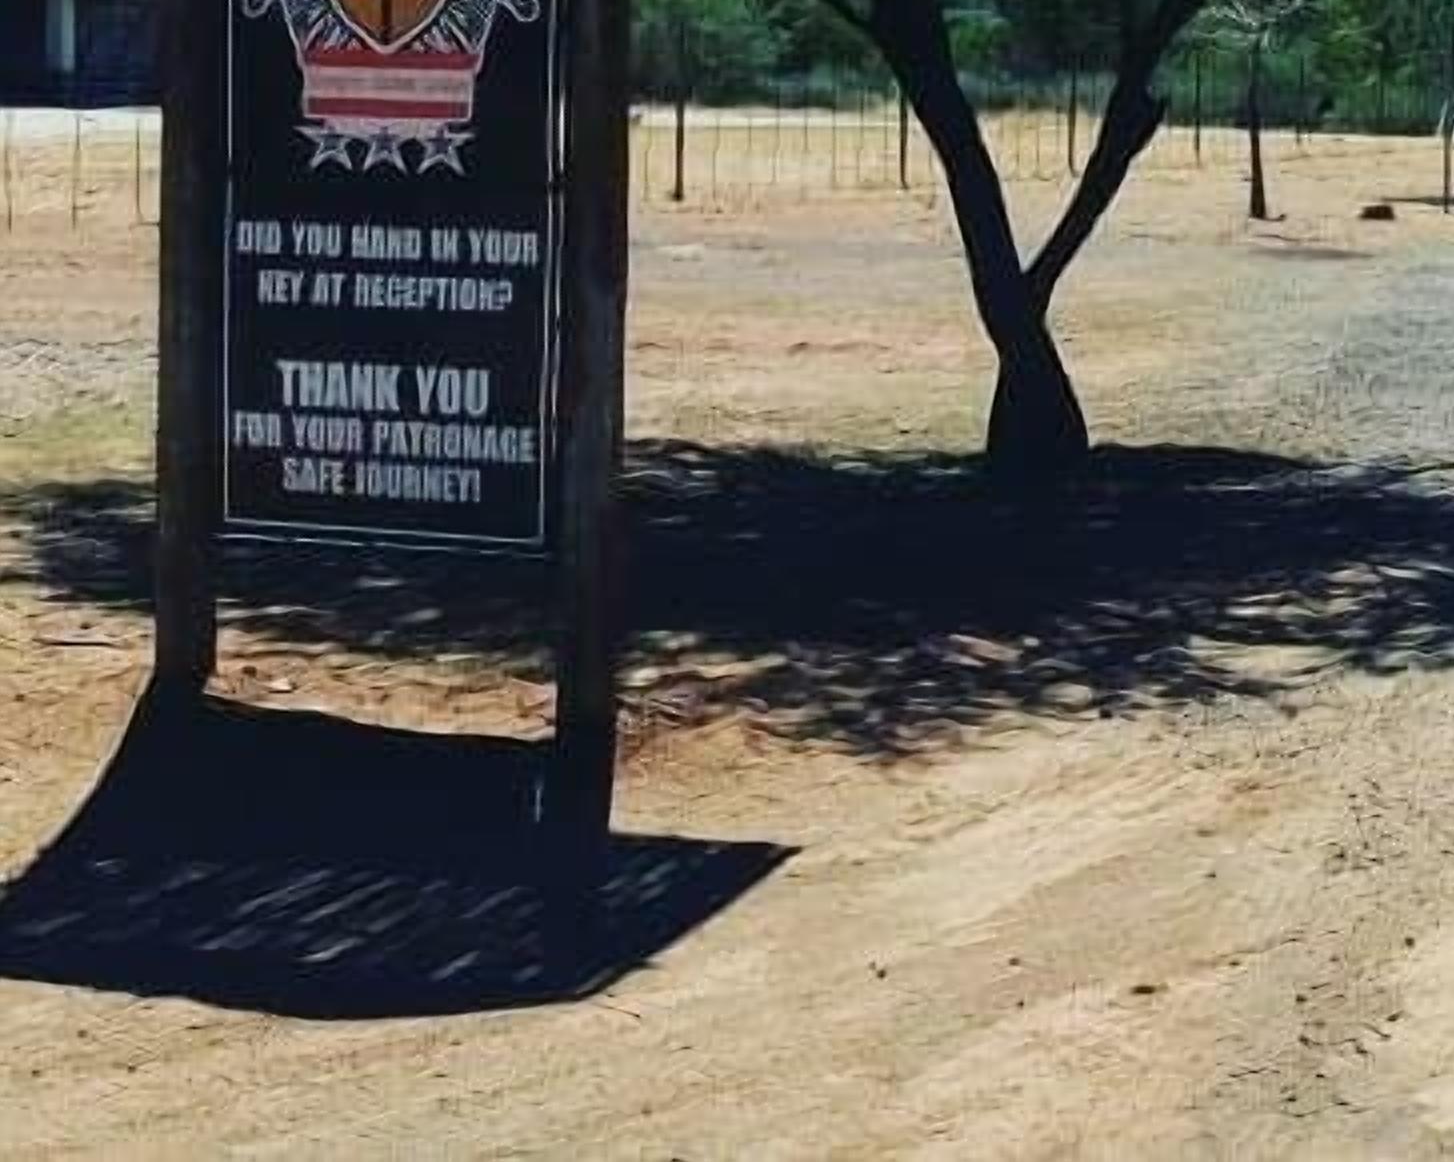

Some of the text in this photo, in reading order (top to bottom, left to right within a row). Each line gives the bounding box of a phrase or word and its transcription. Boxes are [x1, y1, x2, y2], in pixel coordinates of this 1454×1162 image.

[293, 221, 341, 257] YOU
[277, 359, 490, 416] THANK YOU
[283, 457, 345, 494] SAFE
